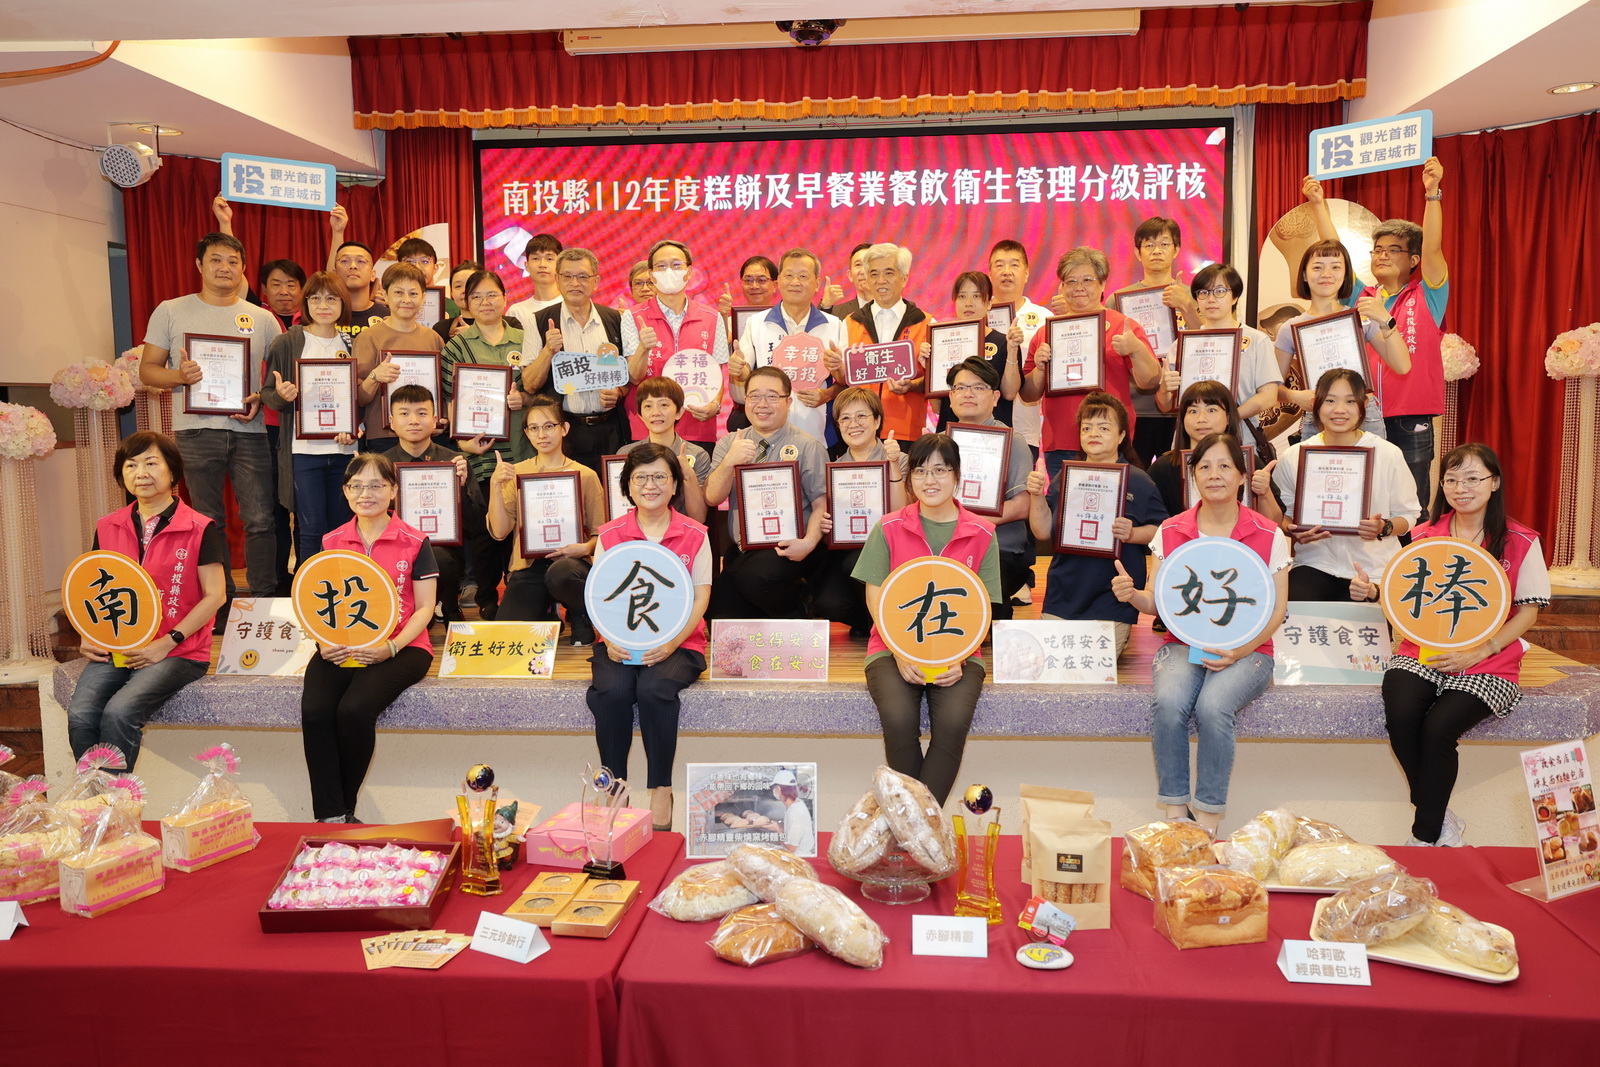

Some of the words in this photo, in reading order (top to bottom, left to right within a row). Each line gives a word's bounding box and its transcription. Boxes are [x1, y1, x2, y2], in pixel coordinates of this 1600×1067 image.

[1360, 124, 1418, 146] 觀光首都
[1321, 135, 1354, 170] 投
[1359, 143, 1418, 164] 宜居城市
[233, 164, 265, 195] 投
[270, 168, 322, 185] 觀光首都
[270, 186, 322, 201] 宜居城市
[502, 162, 1207, 216] 南投縣112年度糕餅及早餐業餐飲衛生管理分級評核
[673, 353, 708, 369] 幸福
[784, 346, 819, 363] 幸福
[864, 349, 896, 365] 衛生
[555, 356, 593, 379] 南投
[782, 366, 818, 382] 南投
[855, 363, 907, 381] 好放心
[584, 370, 622, 385] 好棒棒
[673, 372, 708, 386] 南投
[166, 561, 185, 619] 南投縣政府
[603, 560, 676, 633] 食
[1171, 564, 1258, 627] 好
[1399, 554, 1489, 639] 棒
[84, 567, 138, 639] 南
[313, 575, 379, 630] 投
[898, 580, 968, 643] 在
[749, 632, 825, 648] 吃得安全
[1043, 634, 1111, 650] 吃得安全
[1283, 625, 1380, 647] 守護食安
[448, 640, 547, 657] 衛生好放心
[747, 654, 826, 672] 食在安心
[1044, 654, 1114, 670] 食在安心
[479, 926, 527, 949] 三元珍餅行
[925, 928, 974, 944] 赤腳精靈
[1306, 948, 1346, 962] 哈莉歐
[1295, 963, 1361, 979] 經典麵包坊
